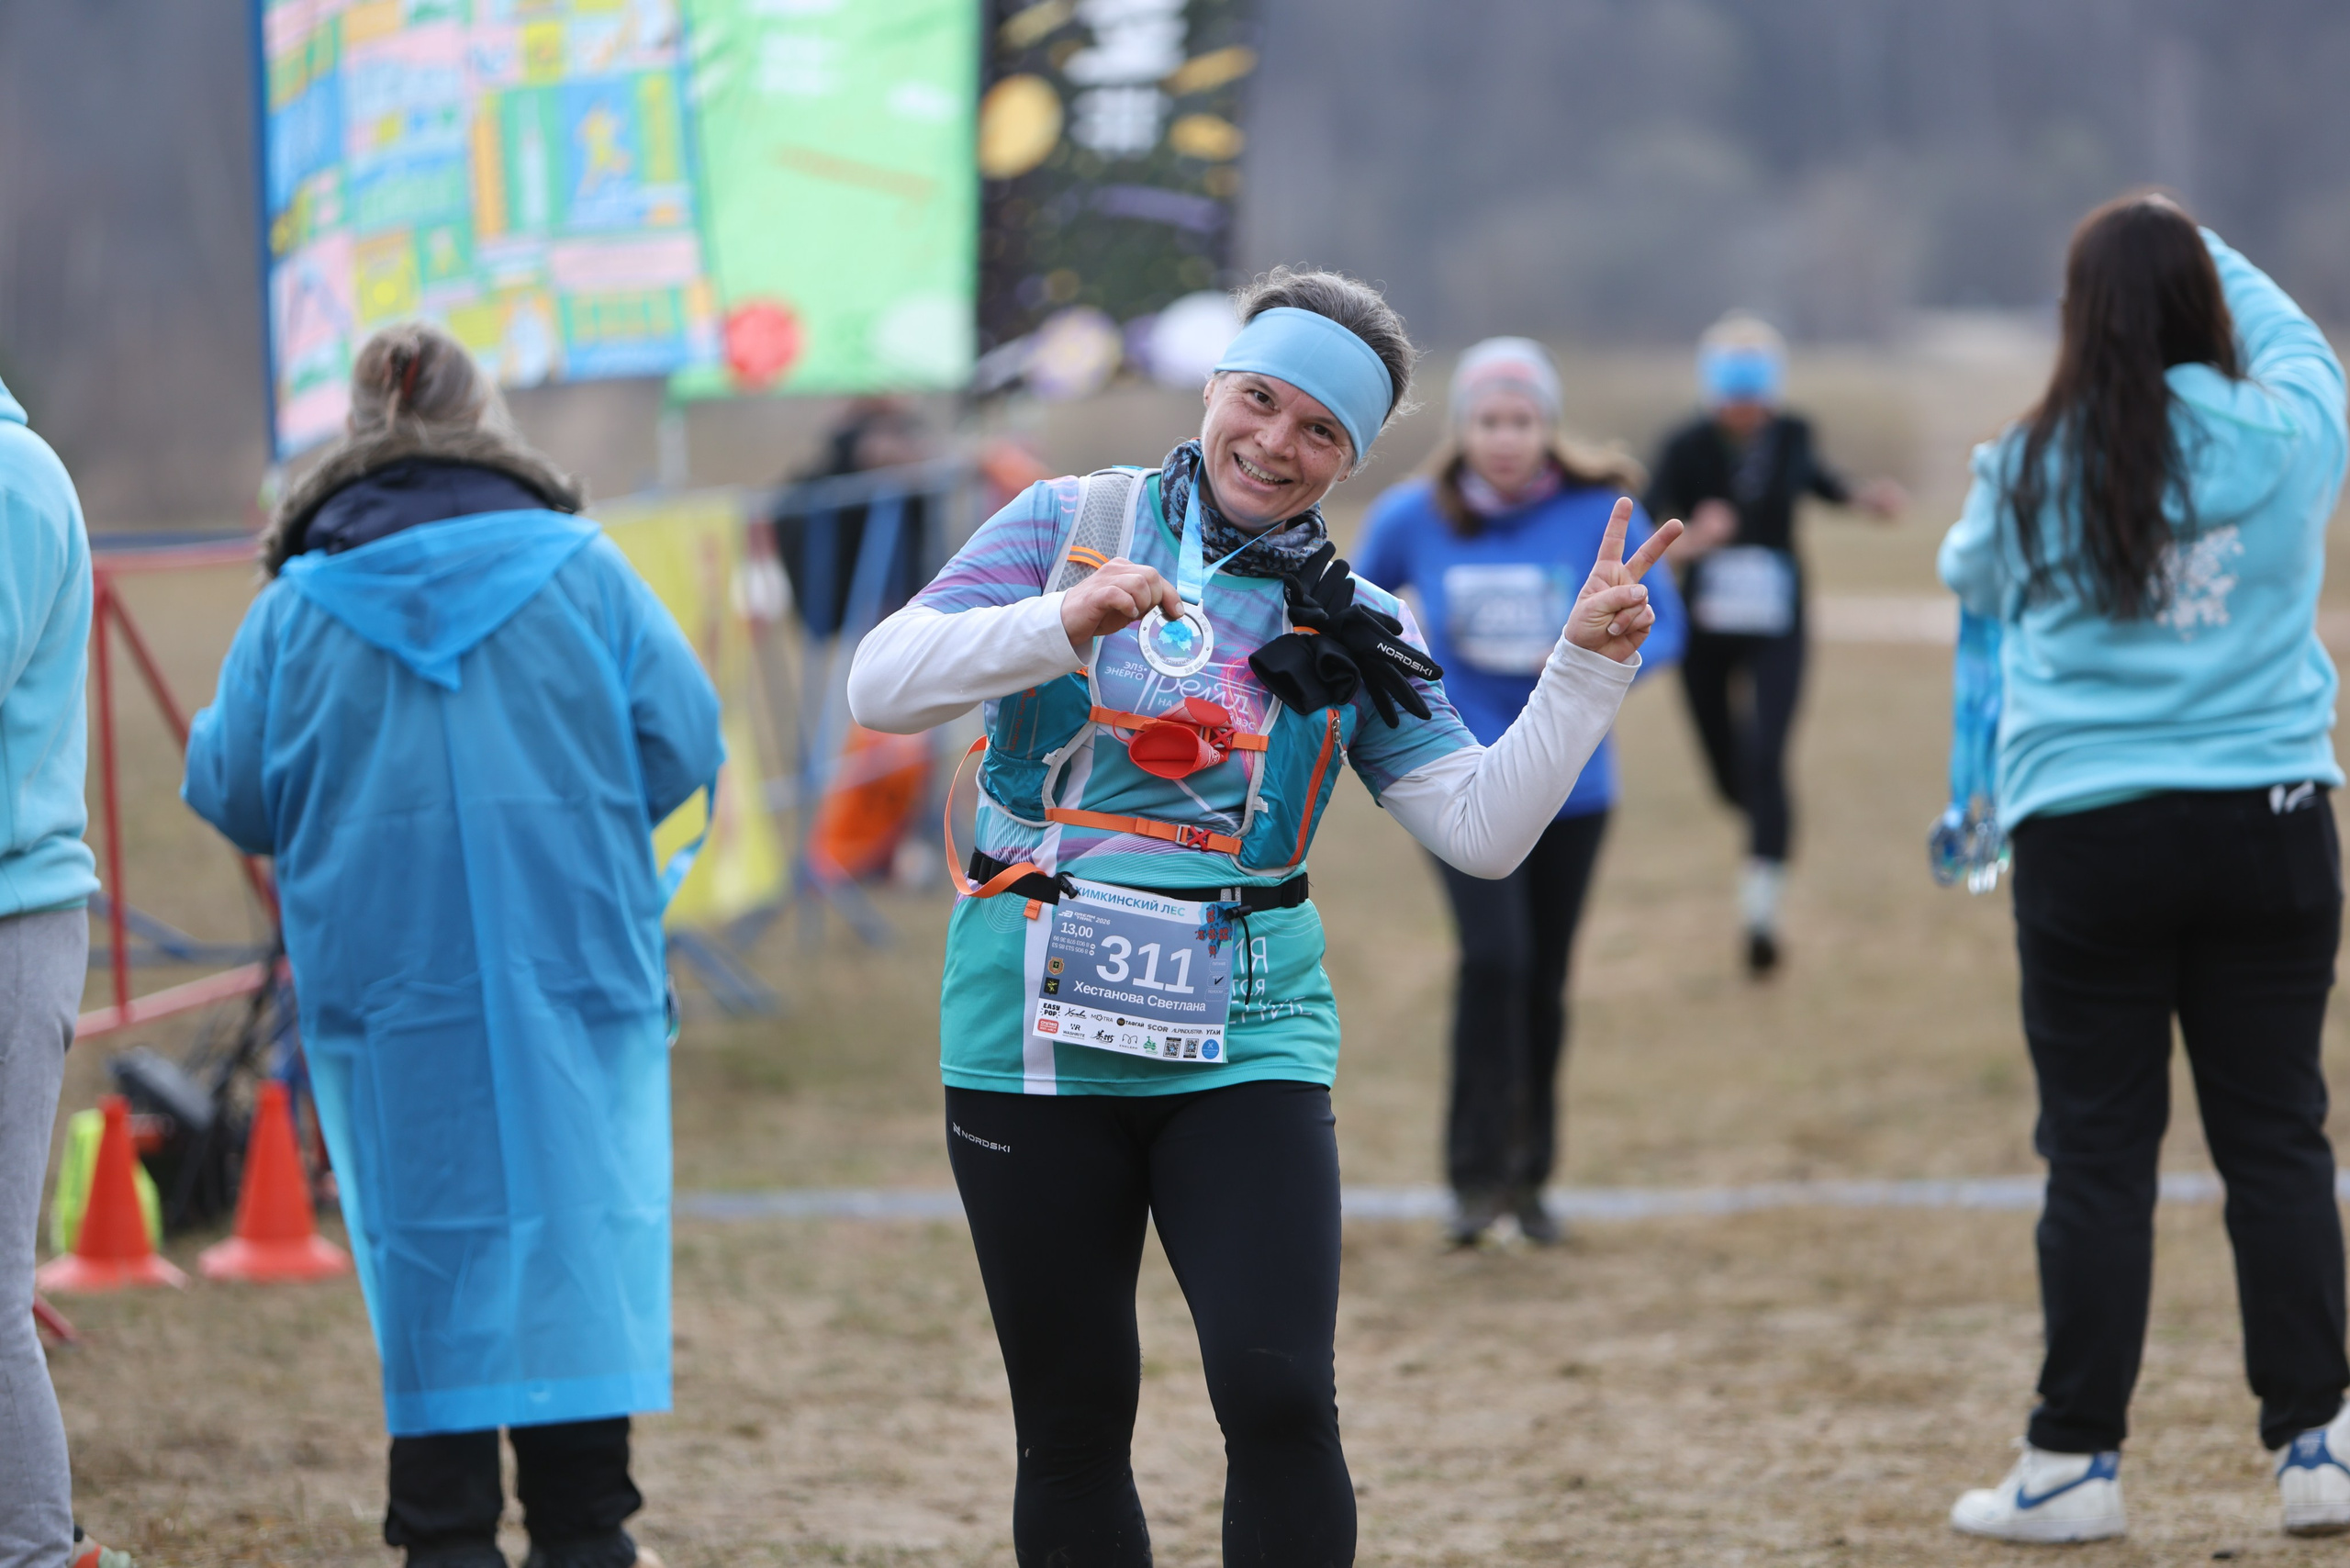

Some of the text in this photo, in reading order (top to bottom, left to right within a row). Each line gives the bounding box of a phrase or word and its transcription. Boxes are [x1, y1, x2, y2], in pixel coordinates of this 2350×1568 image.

[1376, 641, 1434, 678] NORDSKI
[1103, 666, 1145, 681] ЭНЕРГО
[1236, 716, 1256, 731] ВЭС
[1075, 885, 1186, 917] ХИМКИНСКИЙ ЛЕС
[1074, 912, 1096, 920] DREAM
[1095, 917, 1111, 925] 2026
[1060, 922, 1093, 938] 13,00
[1096, 935, 1195, 994] 311
[1073, 980, 1145, 1005] Хестанова
[1147, 994, 1206, 1012] Светлана
[1043, 1002, 1061, 1011] EASY
[1044, 1009, 1058, 1017] POP
[1147, 1024, 1169, 1033] SCOR
[961, 1129, 1012, 1153] NORDSKI
